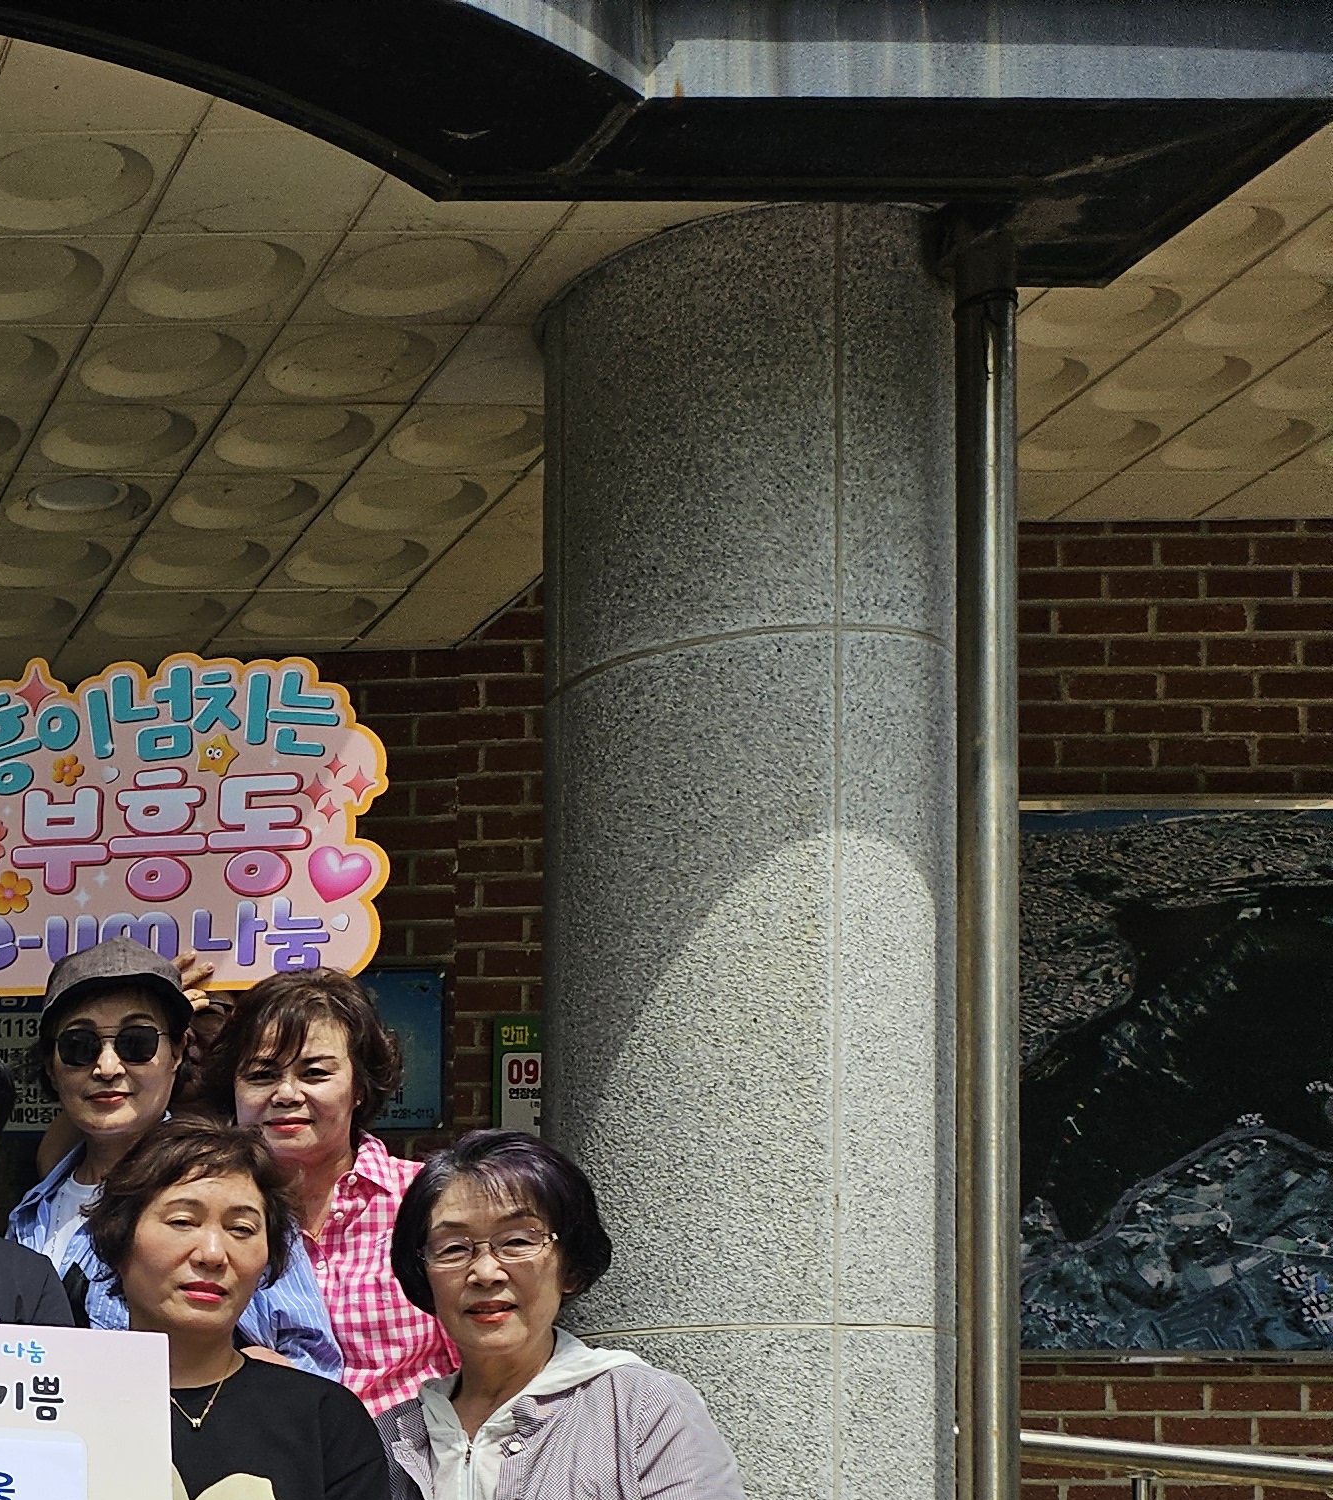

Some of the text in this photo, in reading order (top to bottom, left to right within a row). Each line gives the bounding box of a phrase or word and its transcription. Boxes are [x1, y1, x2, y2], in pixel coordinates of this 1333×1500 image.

[12, 768, 312, 901] 부흥동
[192, 898, 331, 971] 나눔
[501, 1026, 529, 1045] 한파
[2, 1340, 46, 1365] 나눔
